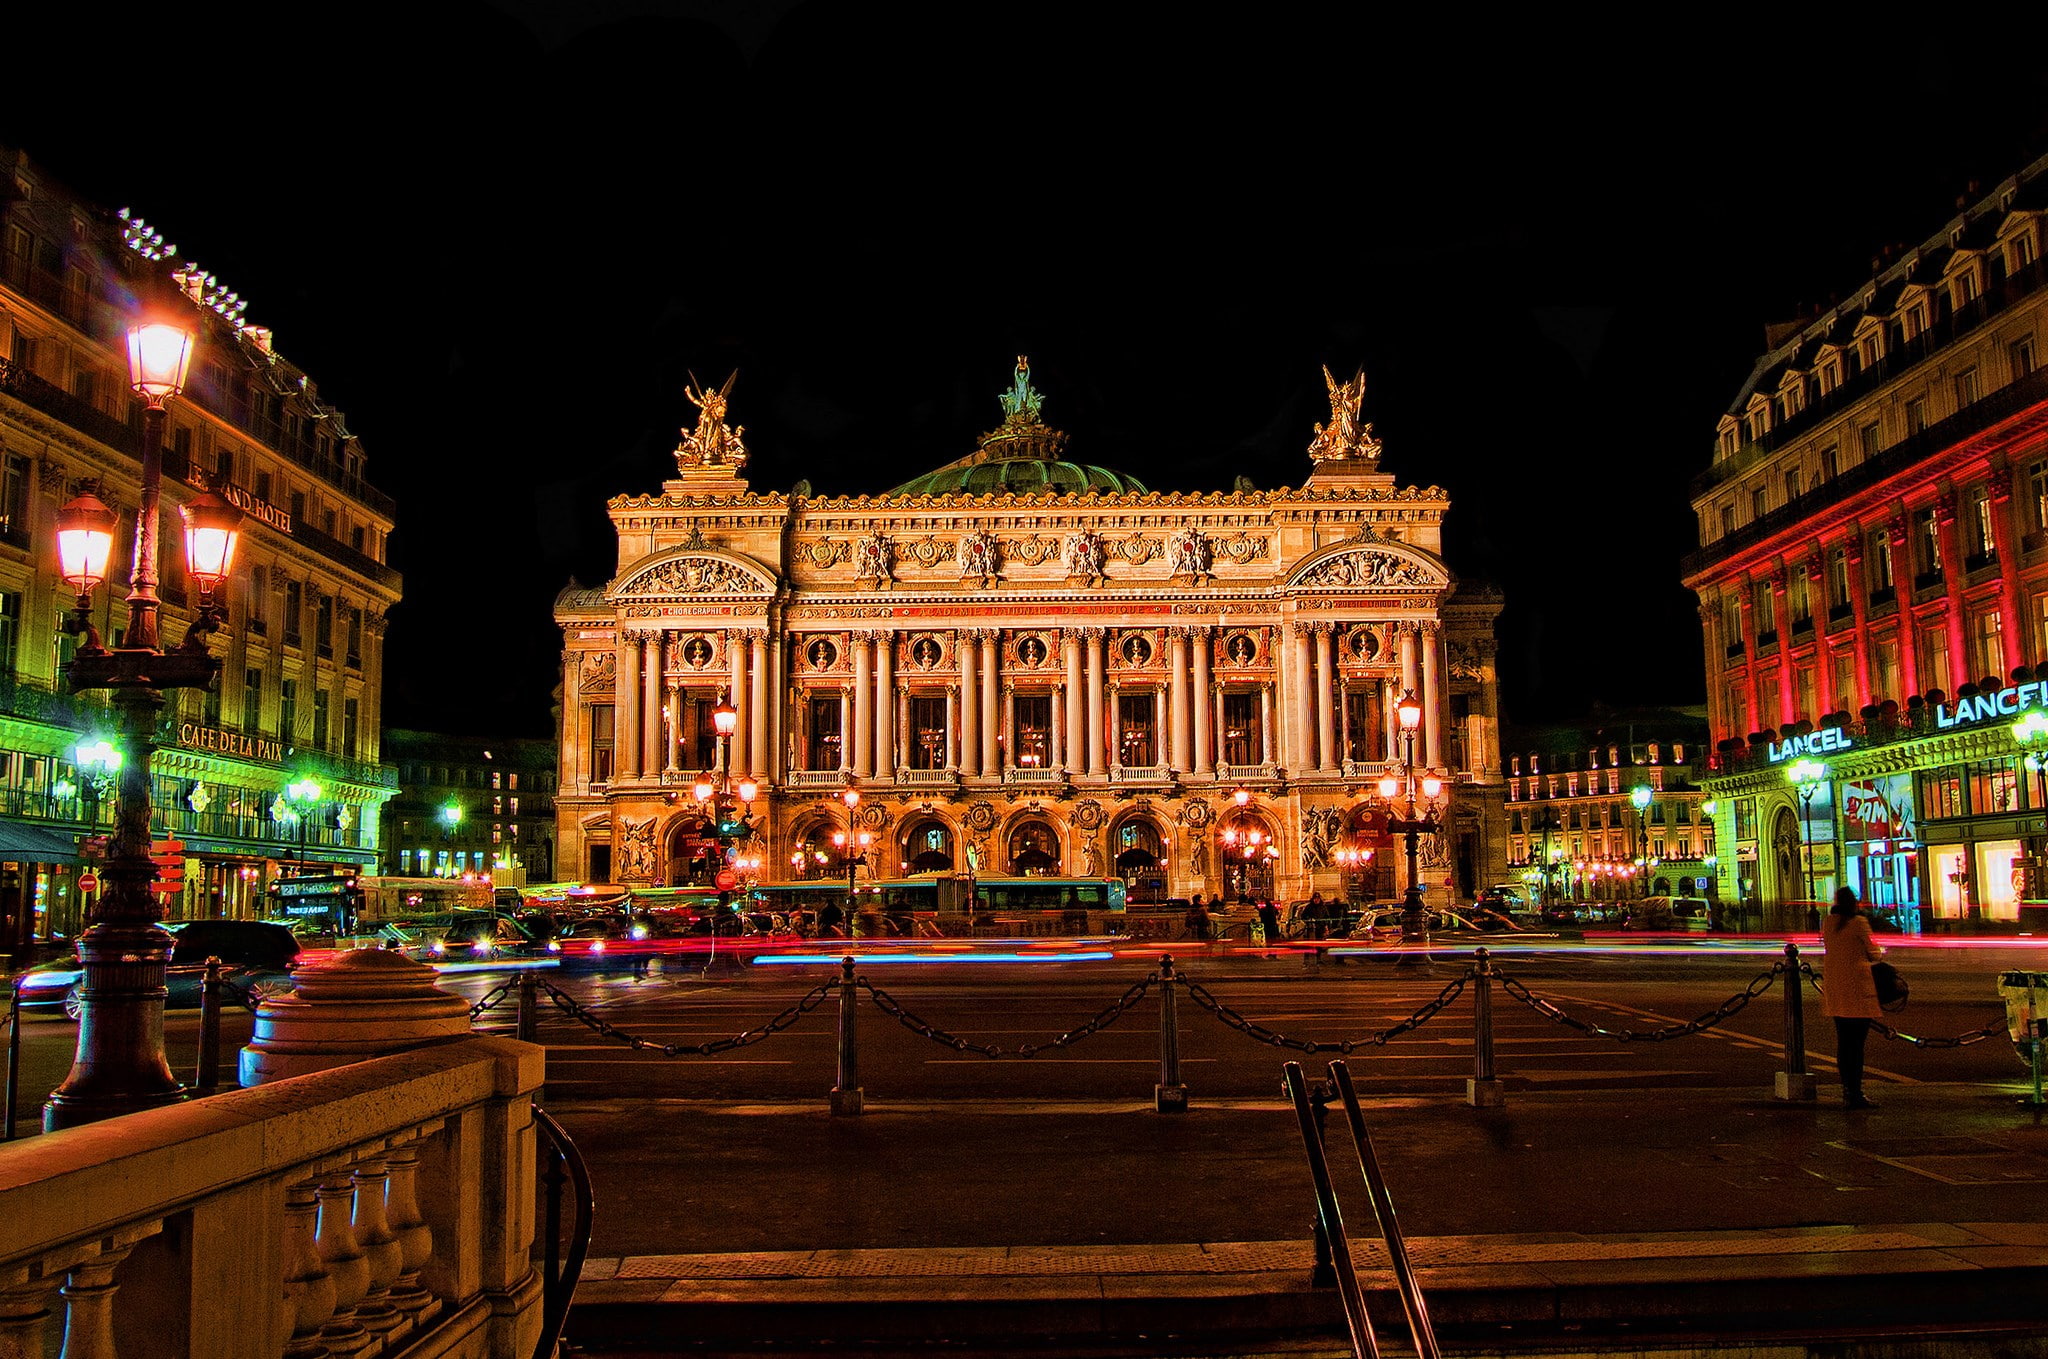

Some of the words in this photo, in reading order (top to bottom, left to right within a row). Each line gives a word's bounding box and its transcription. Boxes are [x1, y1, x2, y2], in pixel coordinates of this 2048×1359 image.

[254, 497, 292, 533] HOTEL
[1061, 606, 1078, 615] DE
[1088, 605, 1145, 615] MUSIQUE
[181, 723, 216, 750] CAFE
[219, 731, 238, 754] DE
[239, 735, 253, 757] LA
[257, 739, 283, 762] PAIX
[1768, 727, 1852, 762] LANCEL
